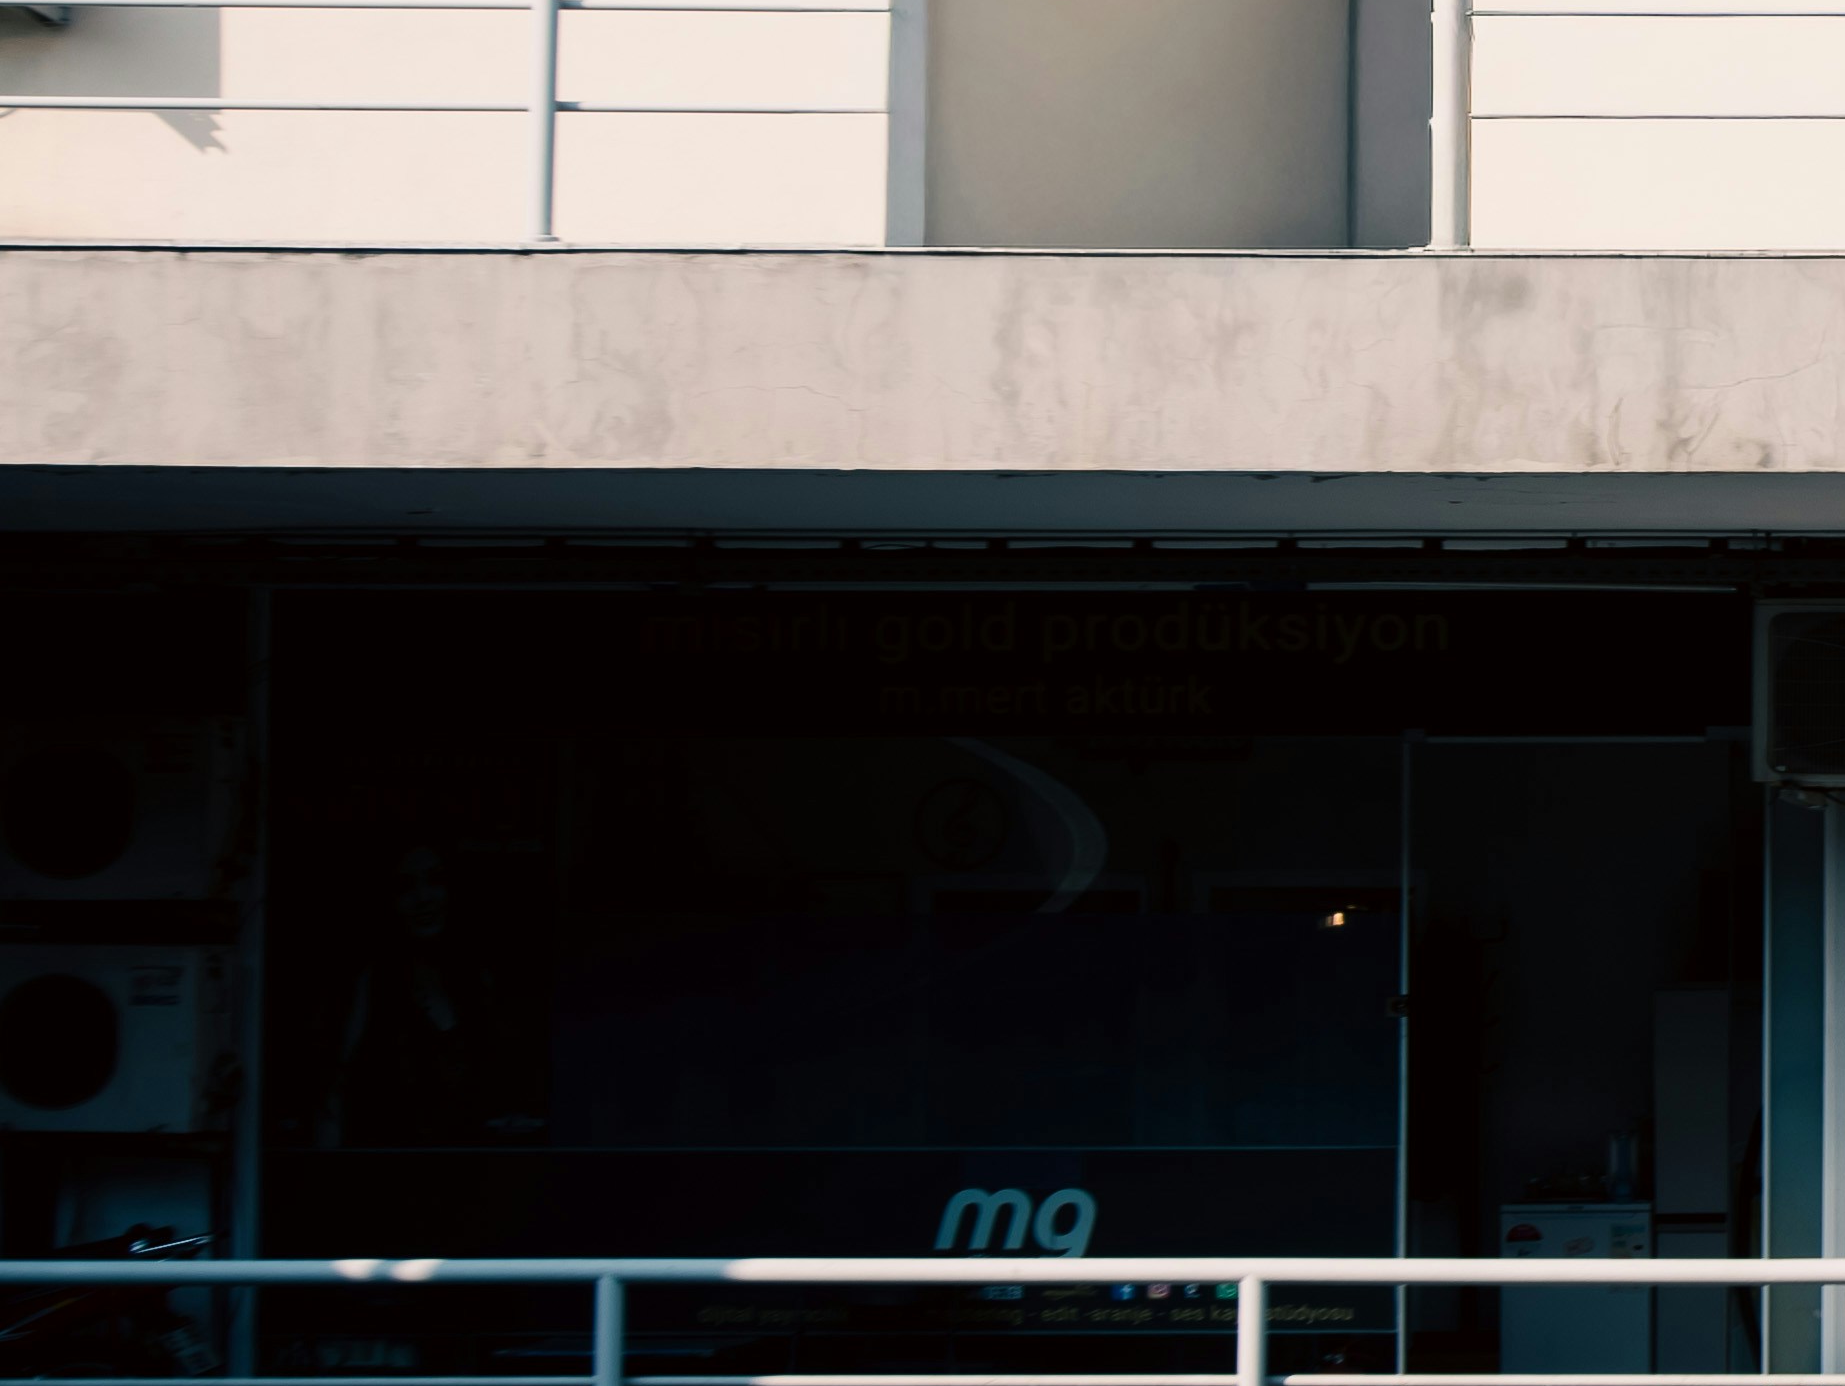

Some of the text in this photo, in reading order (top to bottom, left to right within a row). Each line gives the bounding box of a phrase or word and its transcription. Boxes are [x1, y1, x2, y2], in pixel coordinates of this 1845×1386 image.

[876, 598, 1017, 665] gold
[1042, 597, 1452, 666] prodüksiyon
[1064, 674, 1214, 716] aktürk
[932, 1187, 1099, 1258] mg
